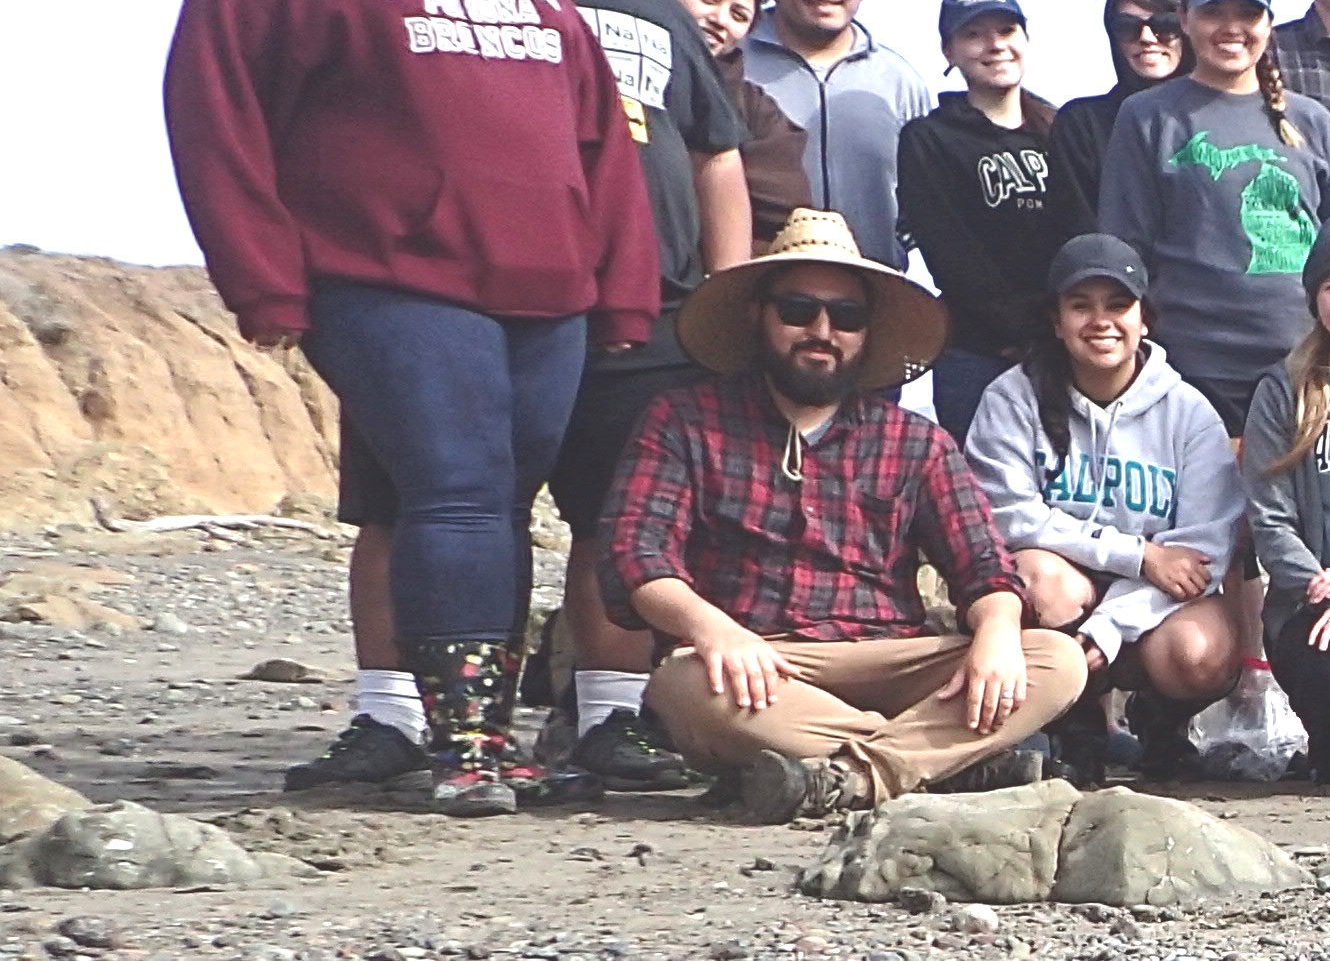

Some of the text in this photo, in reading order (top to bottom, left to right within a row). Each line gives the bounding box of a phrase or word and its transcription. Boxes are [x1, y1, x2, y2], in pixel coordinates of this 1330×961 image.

[404, 17, 563, 64] BRONCOS
[604, 23, 635, 41] Na
[977, 151, 1036, 208] CAL
